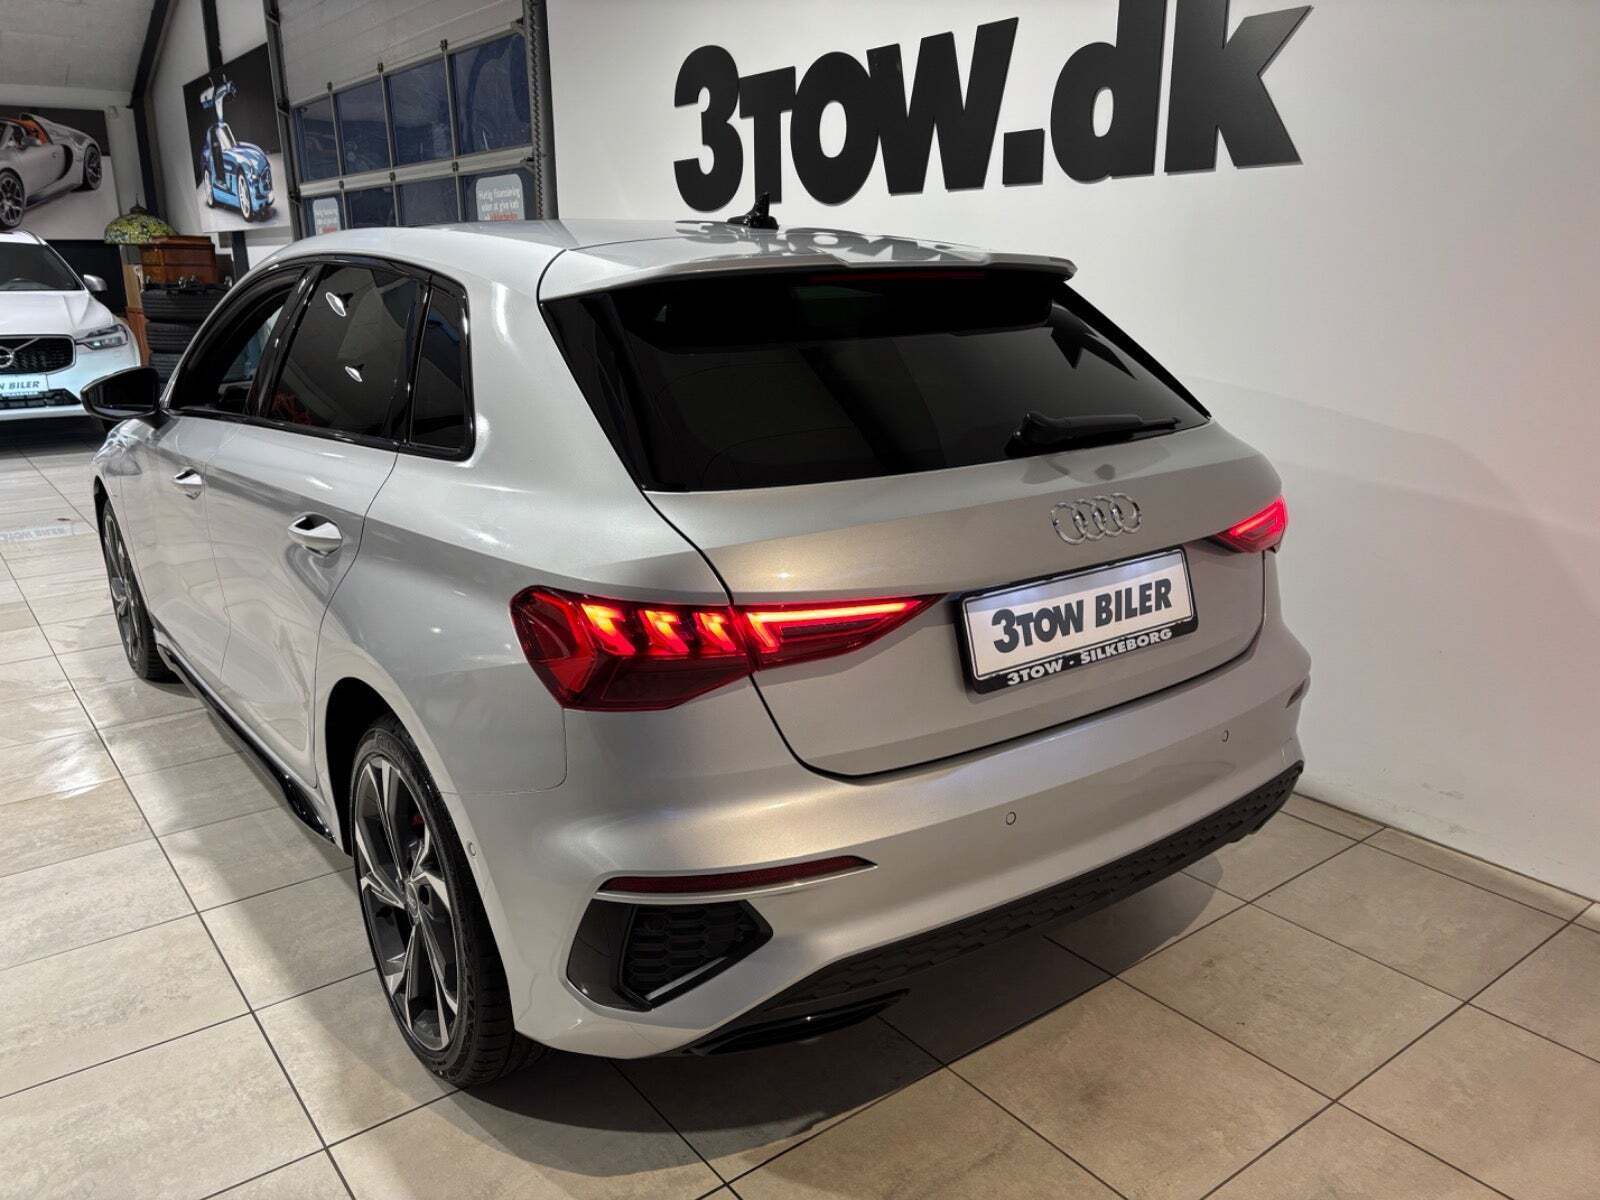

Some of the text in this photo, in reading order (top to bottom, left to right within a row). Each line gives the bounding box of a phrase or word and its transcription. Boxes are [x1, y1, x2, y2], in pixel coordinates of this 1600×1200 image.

[674, 0, 1313, 212] 3TOW.dk
[8, 380, 40, 390] BILER
[991, 578, 1172, 654] 3TOW BILER
[1007, 628, 1173, 686] 3TOW SILKEBORG
